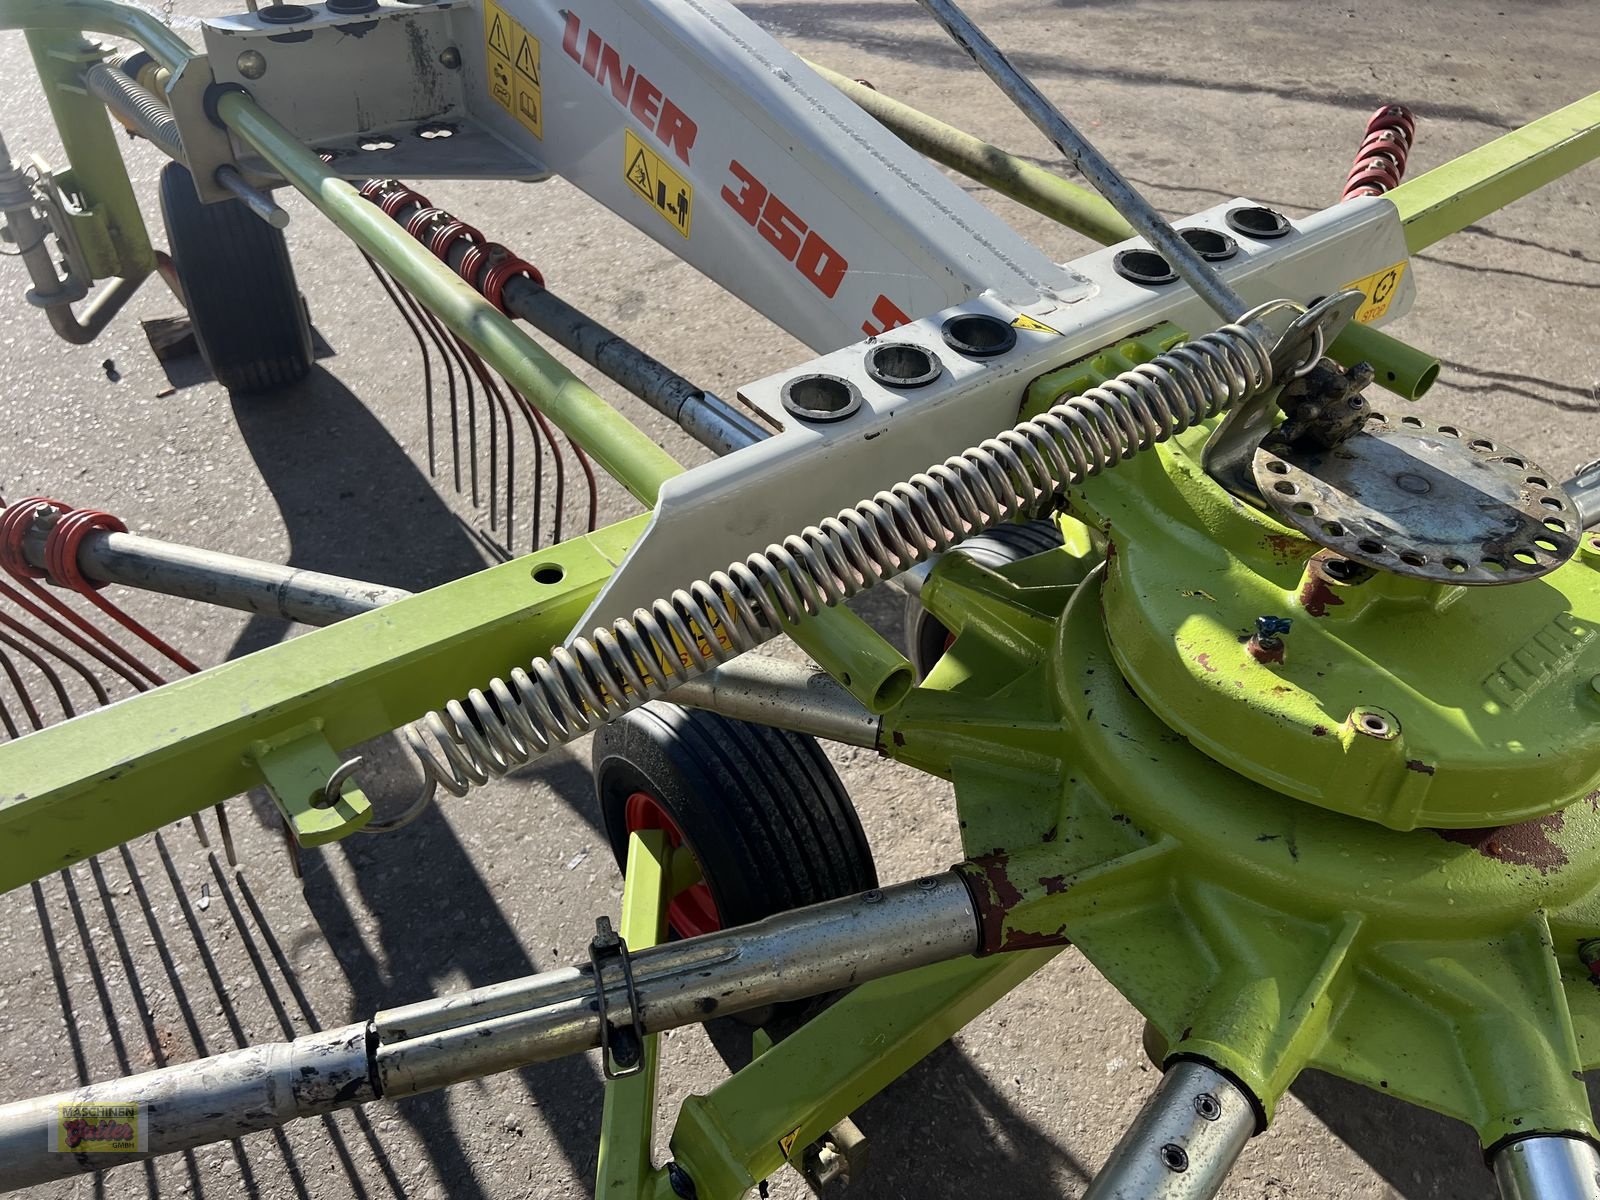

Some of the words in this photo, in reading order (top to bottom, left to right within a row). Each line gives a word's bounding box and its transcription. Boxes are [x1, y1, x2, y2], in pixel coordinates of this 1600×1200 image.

[562, 9, 698, 167] LINER
[720, 159, 848, 298] 350
[1361, 303, 1386, 322] STOP
